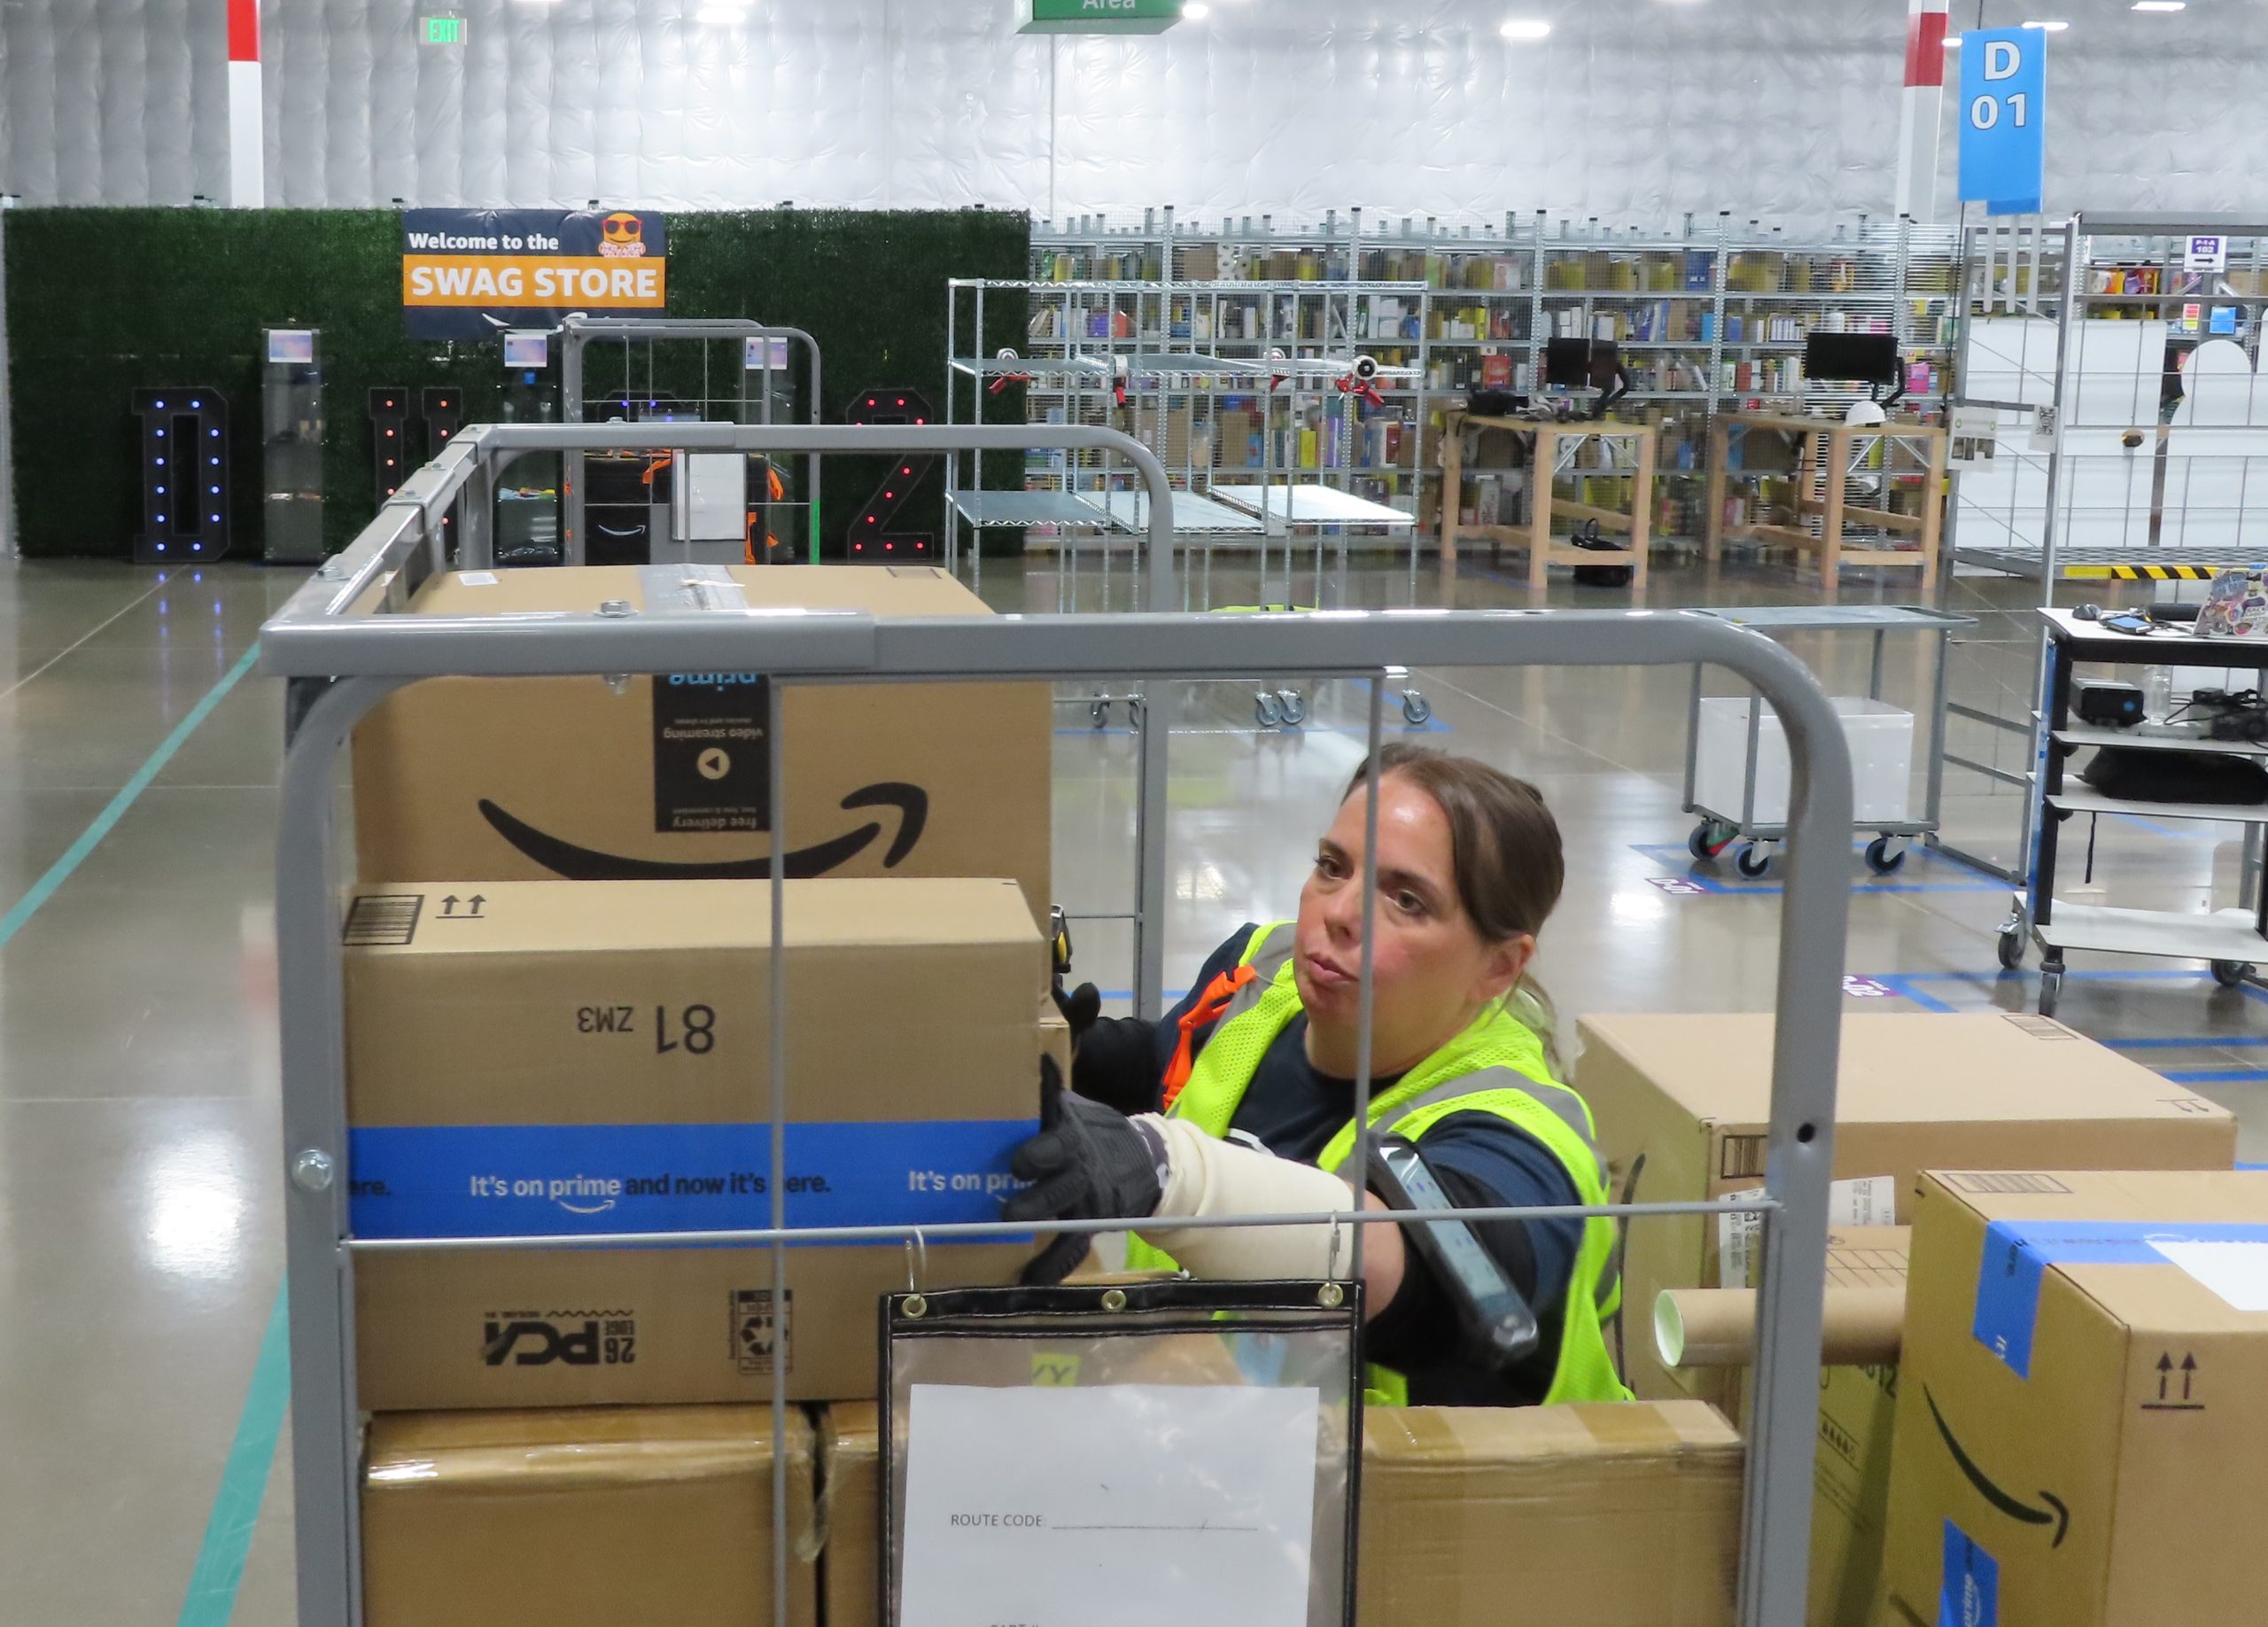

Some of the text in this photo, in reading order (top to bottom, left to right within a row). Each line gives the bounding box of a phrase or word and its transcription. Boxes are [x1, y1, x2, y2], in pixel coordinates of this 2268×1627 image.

[429, 19, 460, 43] EXIT
[1984, 40, 2022, 82] D
[1970, 92, 2026, 130] 01
[408, 232, 559, 251] Welcome to the
[411, 267, 657, 298] SWAG STORE
[664, 727, 764, 742] video streaming
[673, 816, 757, 830] free delivery
[578, 1004, 716, 1055] 81 ZM3
[349, 1179, 391, 1195] ere.
[470, 1172, 832, 1200] It's on prime and now it's ere.
[908, 1170, 946, 1191] It's
[951, 1174, 980, 1191] on
[604, 1320, 635, 1335] EDGE
[485, 1321, 600, 1366] PCA
[605, 1337, 635, 1364] 26
[951, 1514, 998, 1526] ROUTE
